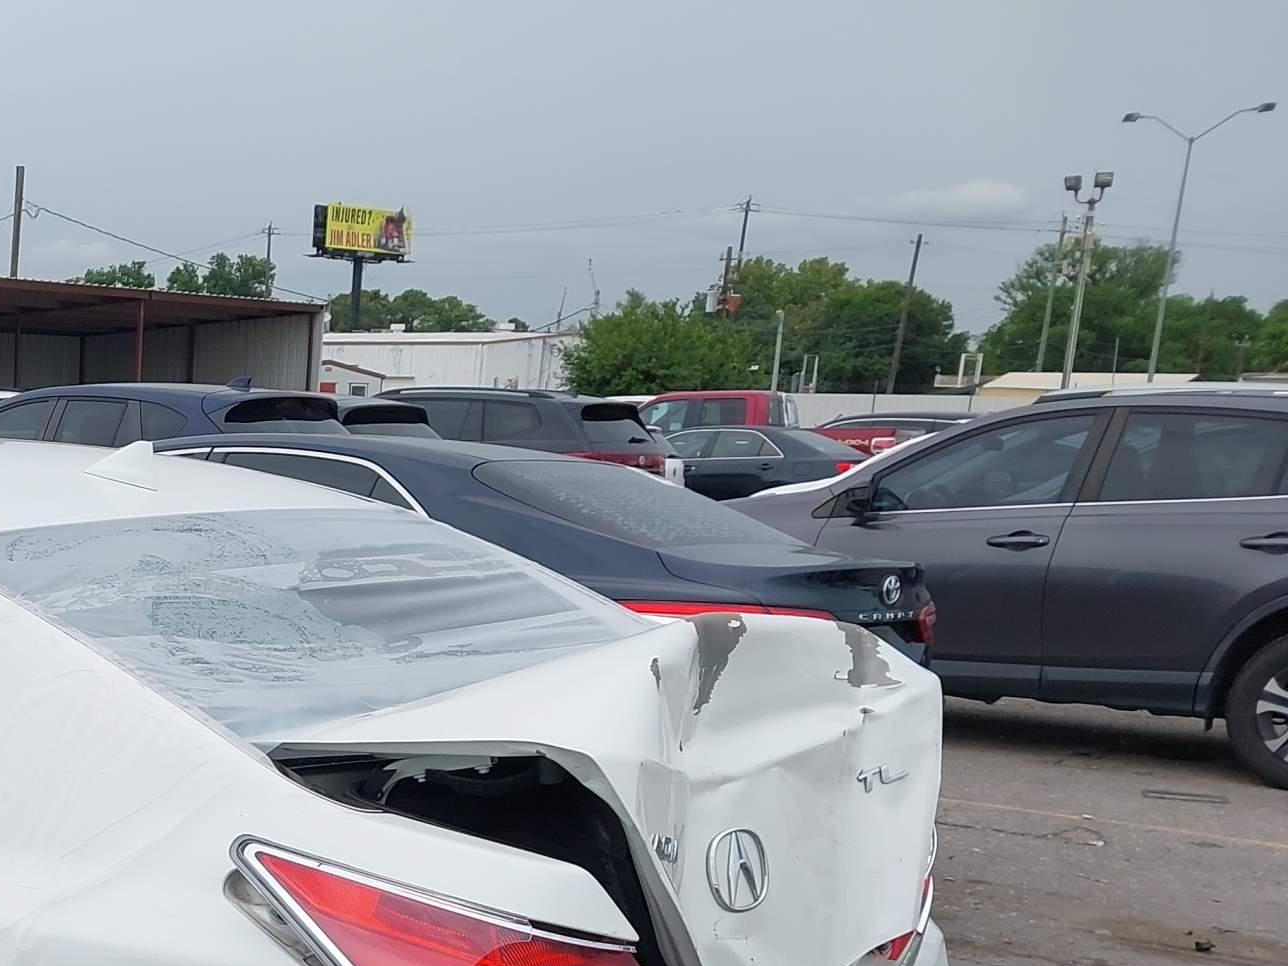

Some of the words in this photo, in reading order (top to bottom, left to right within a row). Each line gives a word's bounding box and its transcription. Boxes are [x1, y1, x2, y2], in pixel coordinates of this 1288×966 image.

[331, 205, 373, 226] INJURED?
[329, 229, 343, 247] JIM
[346, 231, 372, 250] ADLER
[856, 764, 910, 794] TL
